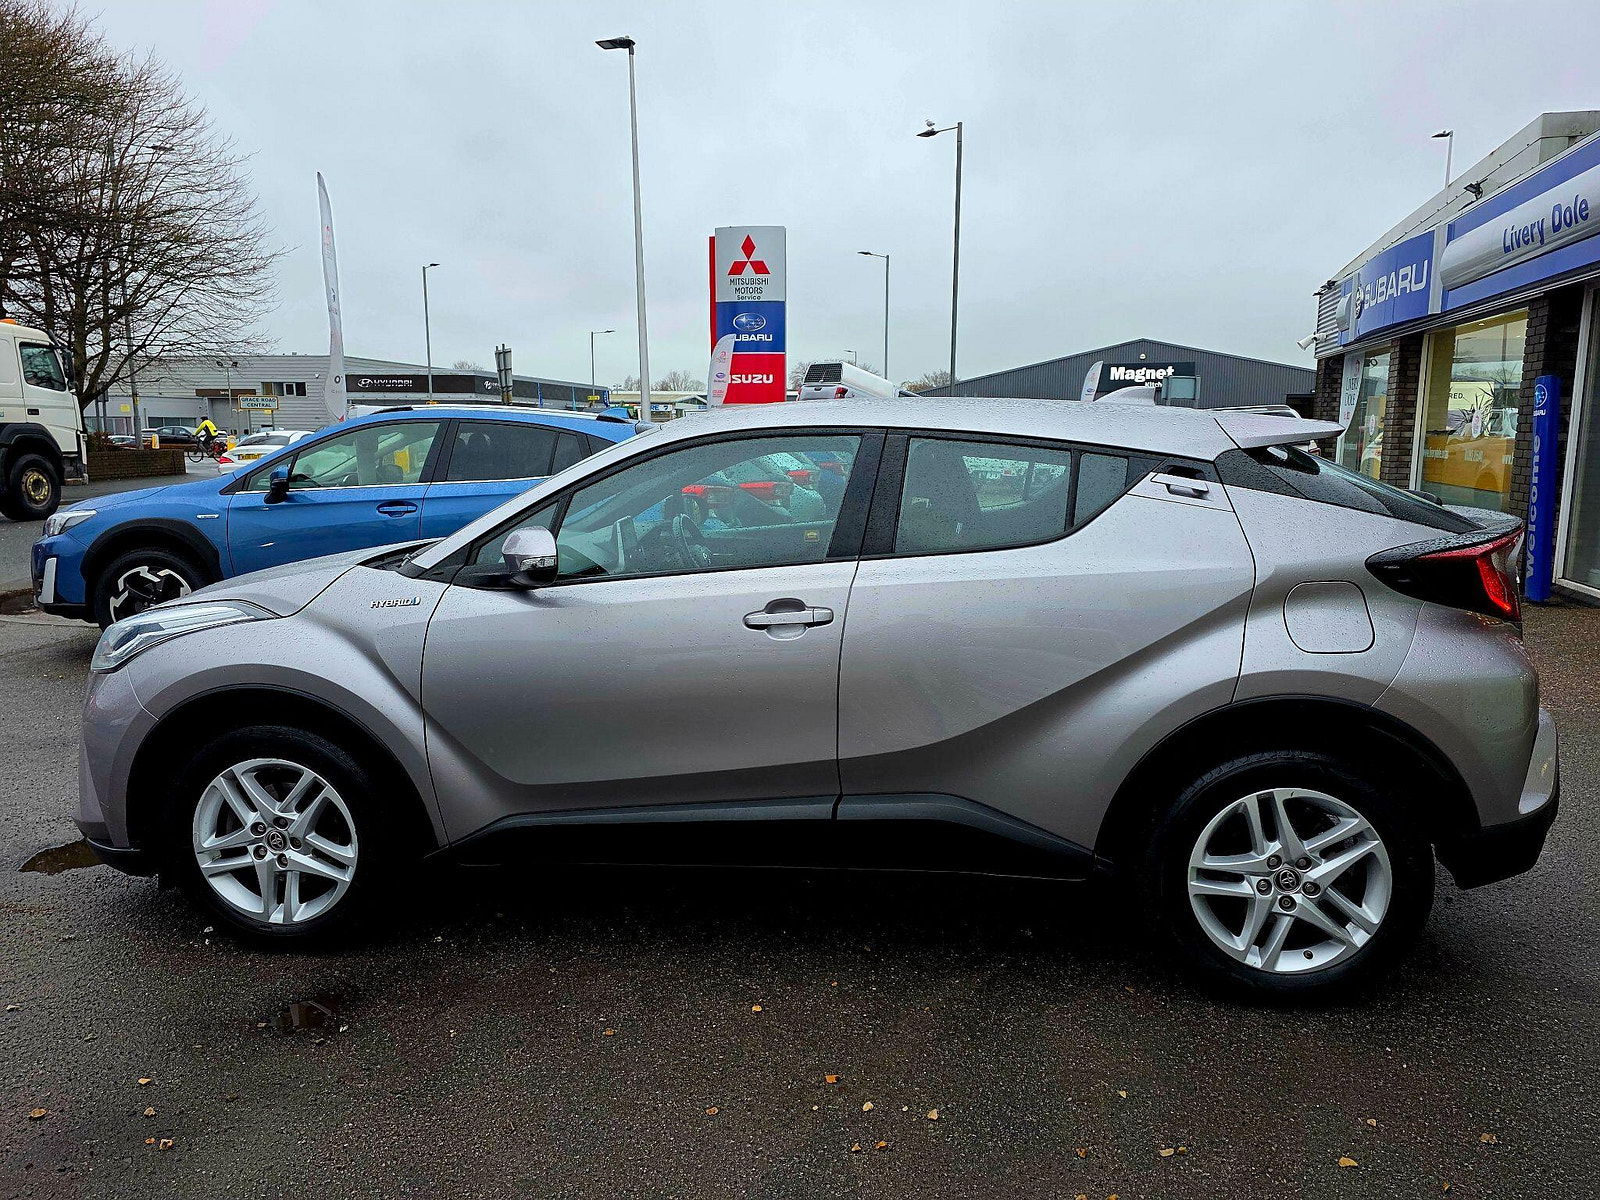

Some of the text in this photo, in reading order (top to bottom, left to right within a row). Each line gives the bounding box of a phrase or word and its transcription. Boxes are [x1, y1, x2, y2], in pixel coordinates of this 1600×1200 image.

[1502, 193, 1590, 254] Livery Dole
[729, 277, 769, 286] MITSUBISHI
[1363, 259, 1429, 311] SUBARU
[734, 286, 764, 295] MOTORS
[734, 333, 773, 342] UBARU
[728, 374, 774, 384] ISUZU
[1109, 365, 1175, 383] Magnet
[1525, 434, 1541, 578] welcome
[370, 598, 413, 609] HYBRID
